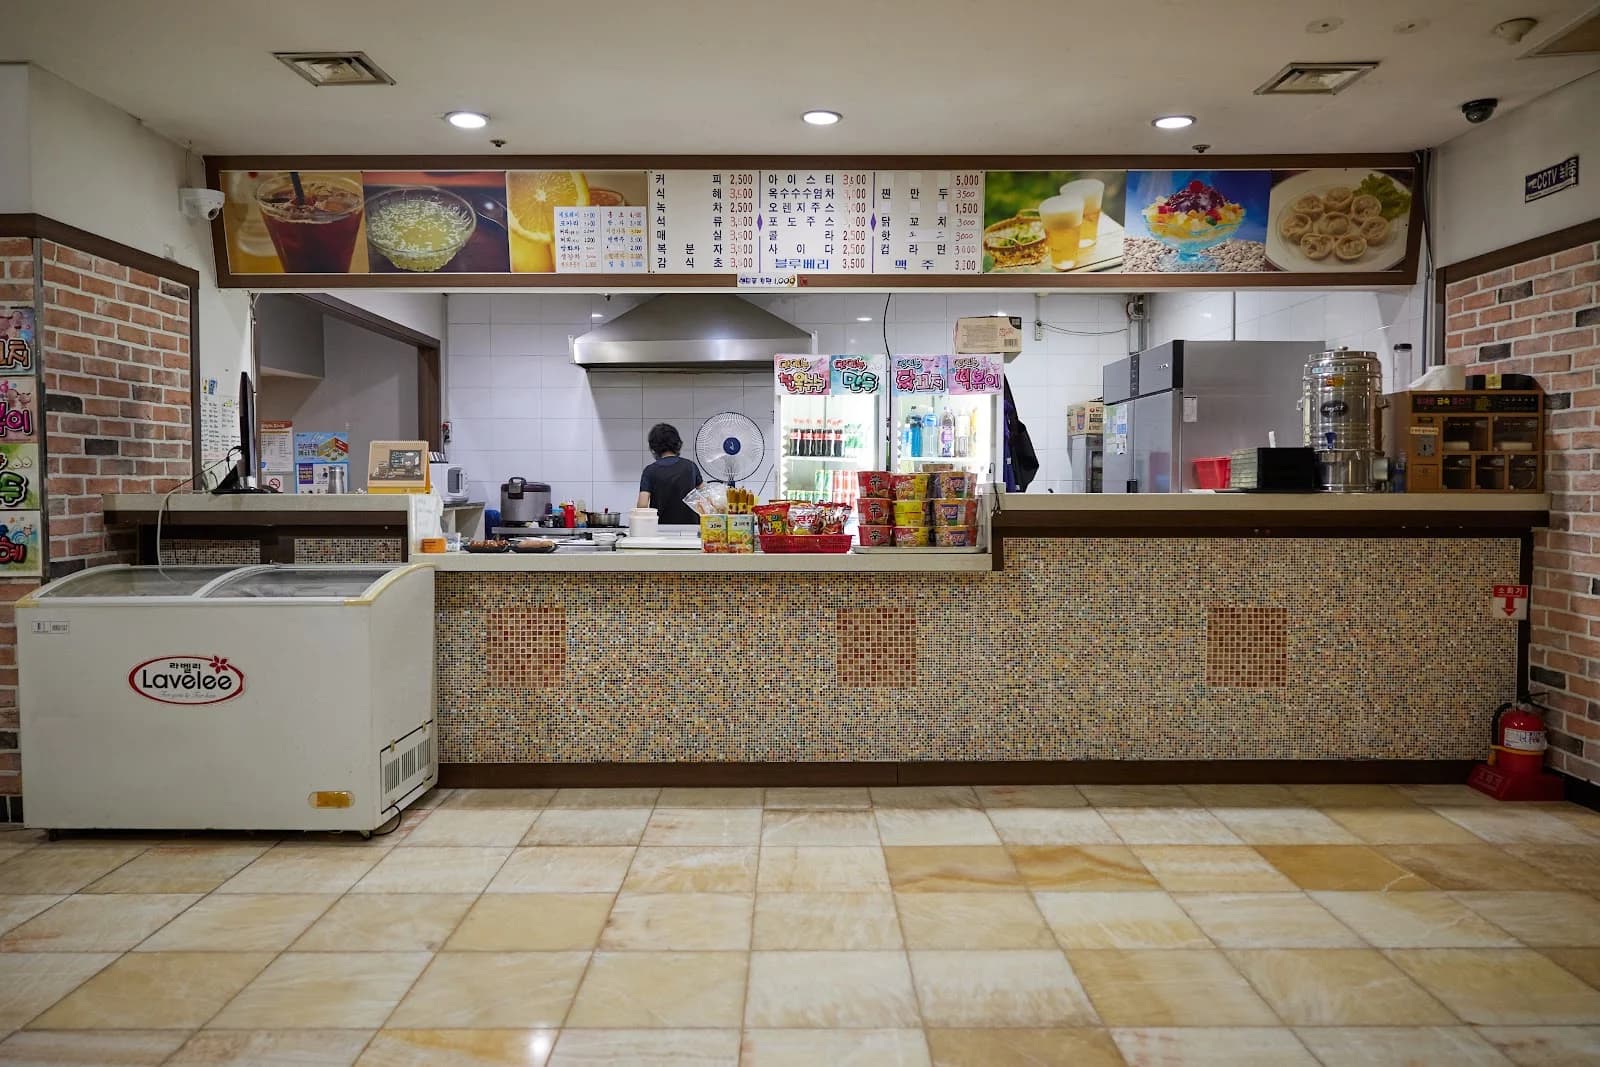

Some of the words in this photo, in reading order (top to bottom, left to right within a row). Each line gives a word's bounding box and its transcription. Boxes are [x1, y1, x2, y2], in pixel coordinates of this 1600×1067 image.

[730, 174, 753, 186] 2,500
[768, 173, 834, 185] 아이스티
[956, 175, 979, 186] 5,000
[1536, 167, 1558, 190] CCTV
[768, 188, 835, 200] 옥수수수염차
[730, 202, 753, 213] 2,500
[768, 202, 835, 214] 오렌지주스
[955, 203, 978, 214] 1,500
[768, 216, 835, 228] 포도주스
[881, 216, 947, 228] 닭꼬치
[657, 243, 723, 255] 복분자
[768, 243, 835, 254] 사이다
[880, 243, 946, 255] 컵라면
[657, 257, 723, 269] 감식초
[775, 258, 829, 270] 블루베리
[842, 258, 865, 269] 3,500
[774, 277, 796, 285] 1,000
[843, 371, 878, 392] 만두
[896, 369, 944, 391] 닭꼬치
[955, 368, 1000, 391] 떡볶이
[1497, 586, 1523, 595] 소화기
[169, 662, 201, 674] 라벨리
[142, 669, 232, 690] Lavelee
